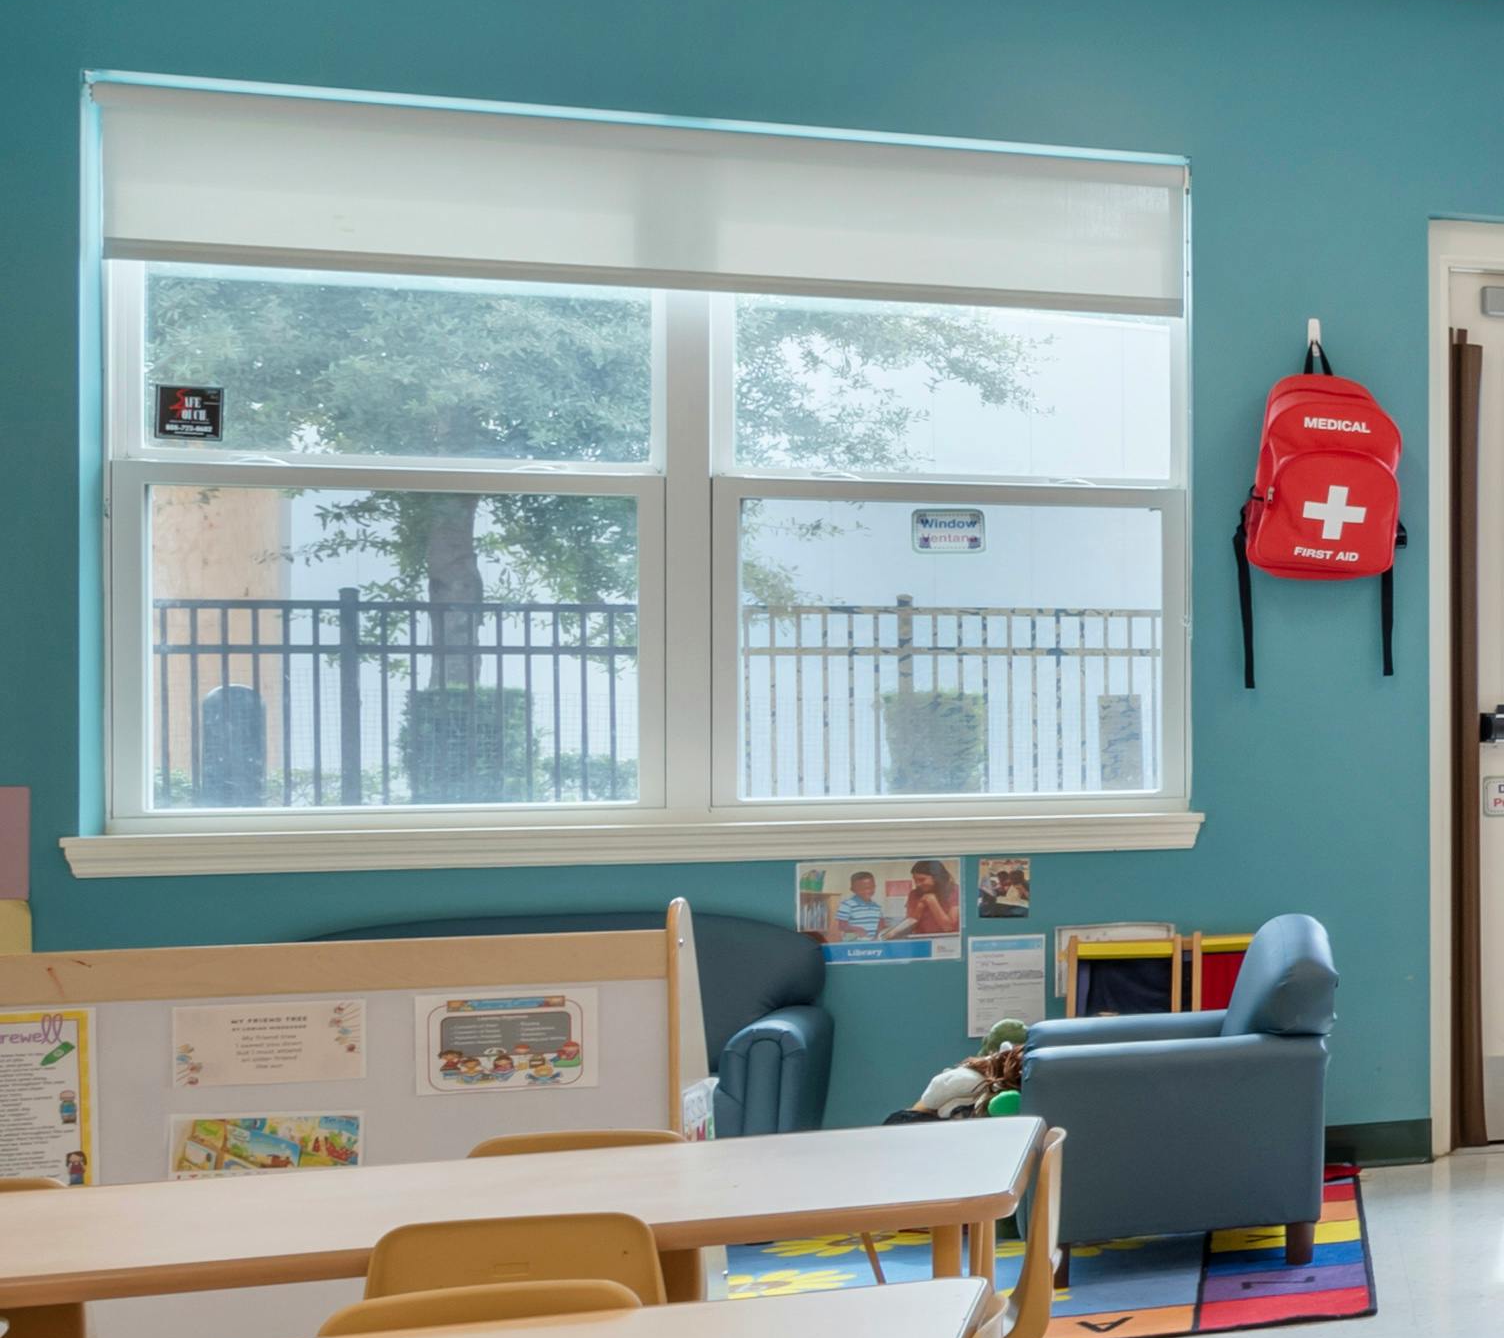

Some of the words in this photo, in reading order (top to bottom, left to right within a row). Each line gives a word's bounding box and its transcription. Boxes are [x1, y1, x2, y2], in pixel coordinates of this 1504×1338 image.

[1303, 416, 1372, 434] MEDICAL
[920, 518, 978, 529] Window
[1293, 546, 1334, 560] FIRST
[1335, 550, 1359, 562] AID
[846, 947, 885, 959] Library
